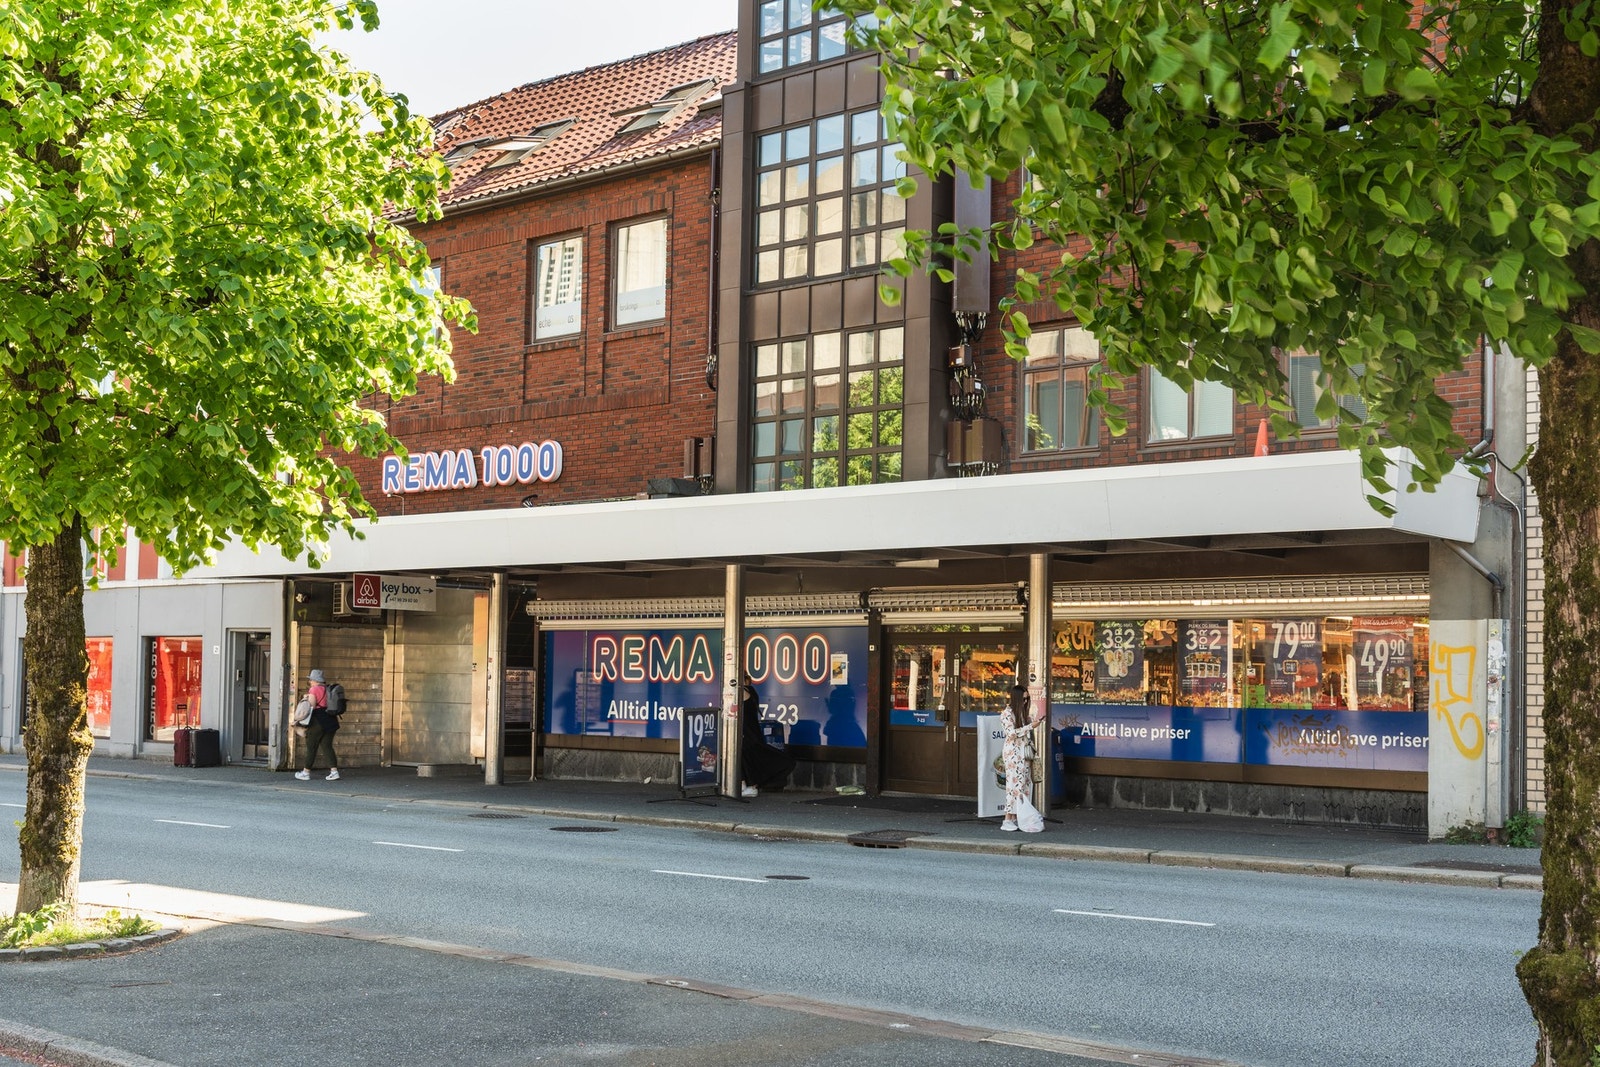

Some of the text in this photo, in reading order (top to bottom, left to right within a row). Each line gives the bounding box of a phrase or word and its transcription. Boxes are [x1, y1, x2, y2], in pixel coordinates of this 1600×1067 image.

[382, 440, 563, 494] REMA 1000
[381, 581, 421, 595] key box
[357, 596, 378, 605] airbnb
[1102, 628, 1114, 649] 3
[1114, 627, 1122, 649] FOR
[1123, 628, 1135, 649] 2
[1185, 629, 1198, 650] 3
[1199, 629, 1208, 650] FOR
[1209, 629, 1221, 650] 2
[1271, 621, 1316, 659] 79 00
[592, 633, 830, 686] REMA 000
[1360, 639, 1405, 674] 49 90
[1084, 670, 1094, 684] 29
[607, 701, 649, 721] Alltid
[758, 703, 799, 726] 7-23
[687, 714, 715, 748] 19 90
[992, 731, 1006, 739] SAL
[1081, 722, 1191, 741] Alltid lave priser
[1346, 733, 1377, 746] ave
[1381, 732, 1429, 749] priser
